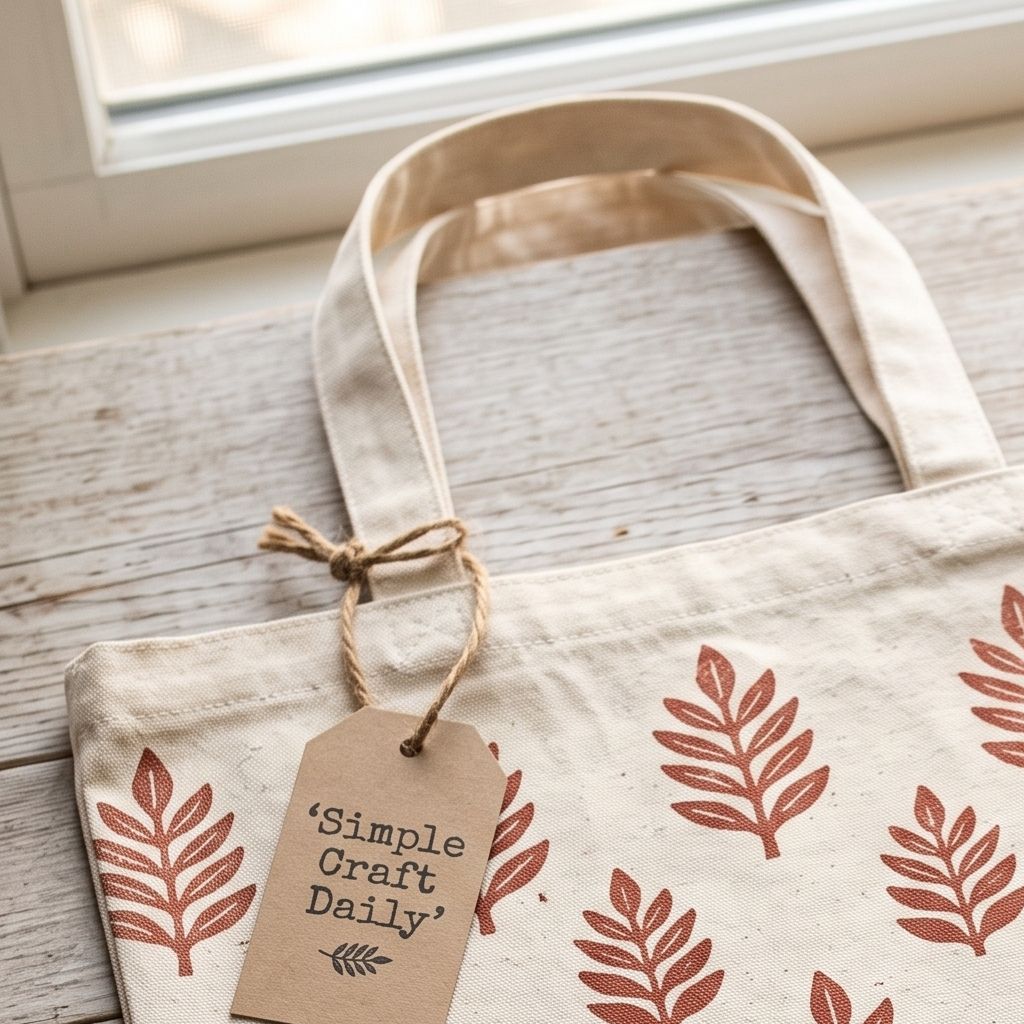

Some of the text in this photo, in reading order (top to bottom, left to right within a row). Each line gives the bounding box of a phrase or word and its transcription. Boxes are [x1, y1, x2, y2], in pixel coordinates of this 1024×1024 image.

[308, 802, 466, 858] ‘Simple
[318, 847, 436, 894] Craft
[305, 884, 445, 939] Daily’
